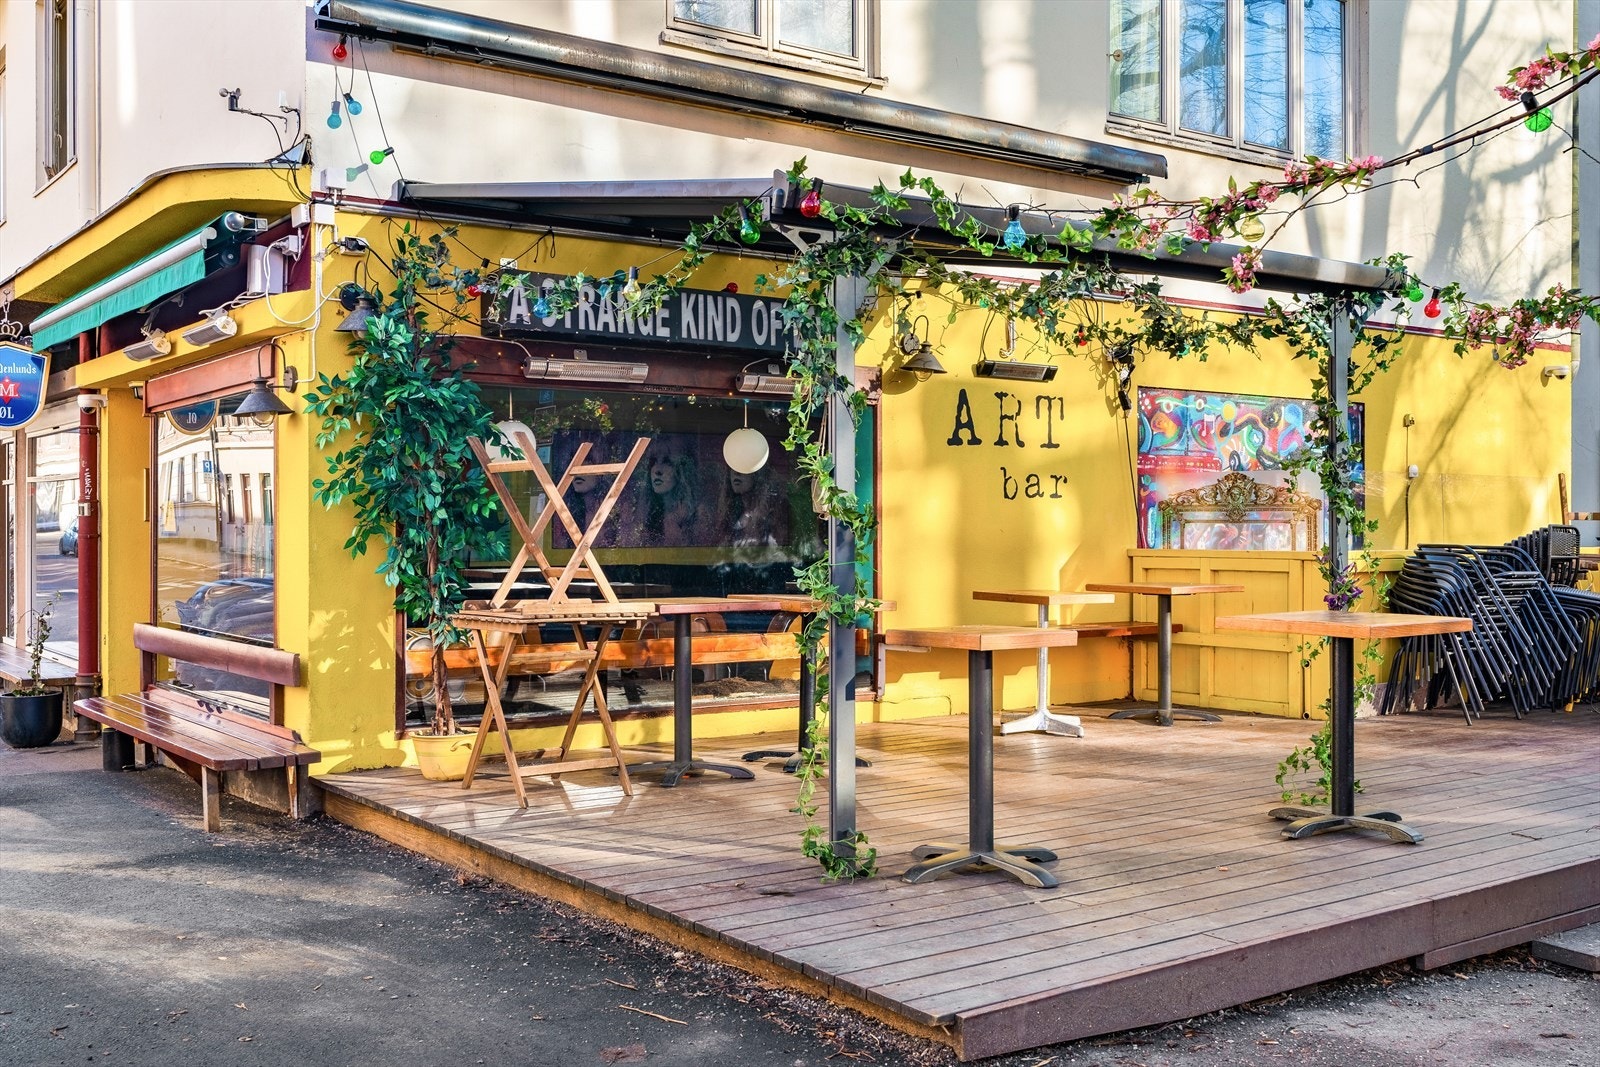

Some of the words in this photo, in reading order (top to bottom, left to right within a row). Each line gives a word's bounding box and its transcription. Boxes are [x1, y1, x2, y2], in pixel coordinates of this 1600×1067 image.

[509, 279, 532, 325] A
[681, 292, 742, 343] KIND
[751, 299, 784, 347] OF
[947, 388, 1064, 448] ART
[1000, 466, 1068, 500] bar
